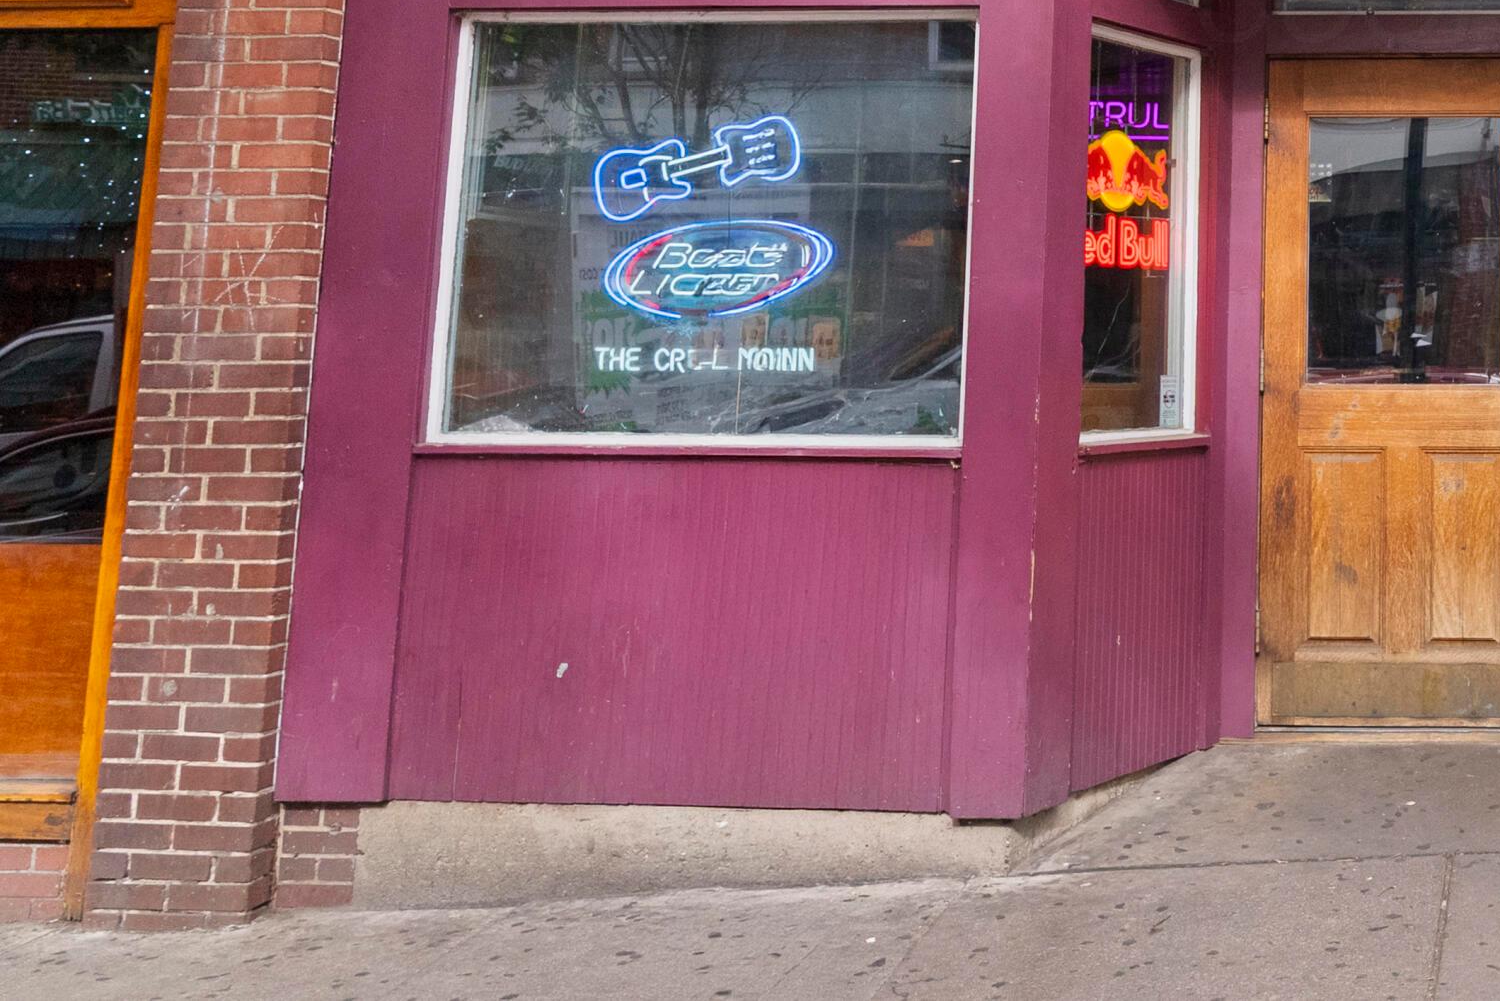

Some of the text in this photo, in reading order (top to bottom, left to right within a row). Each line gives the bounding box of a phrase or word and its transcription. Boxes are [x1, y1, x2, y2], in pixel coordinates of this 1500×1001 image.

[1084, 213, 1169, 270] ed Bull
[594, 346, 642, 372] THE
